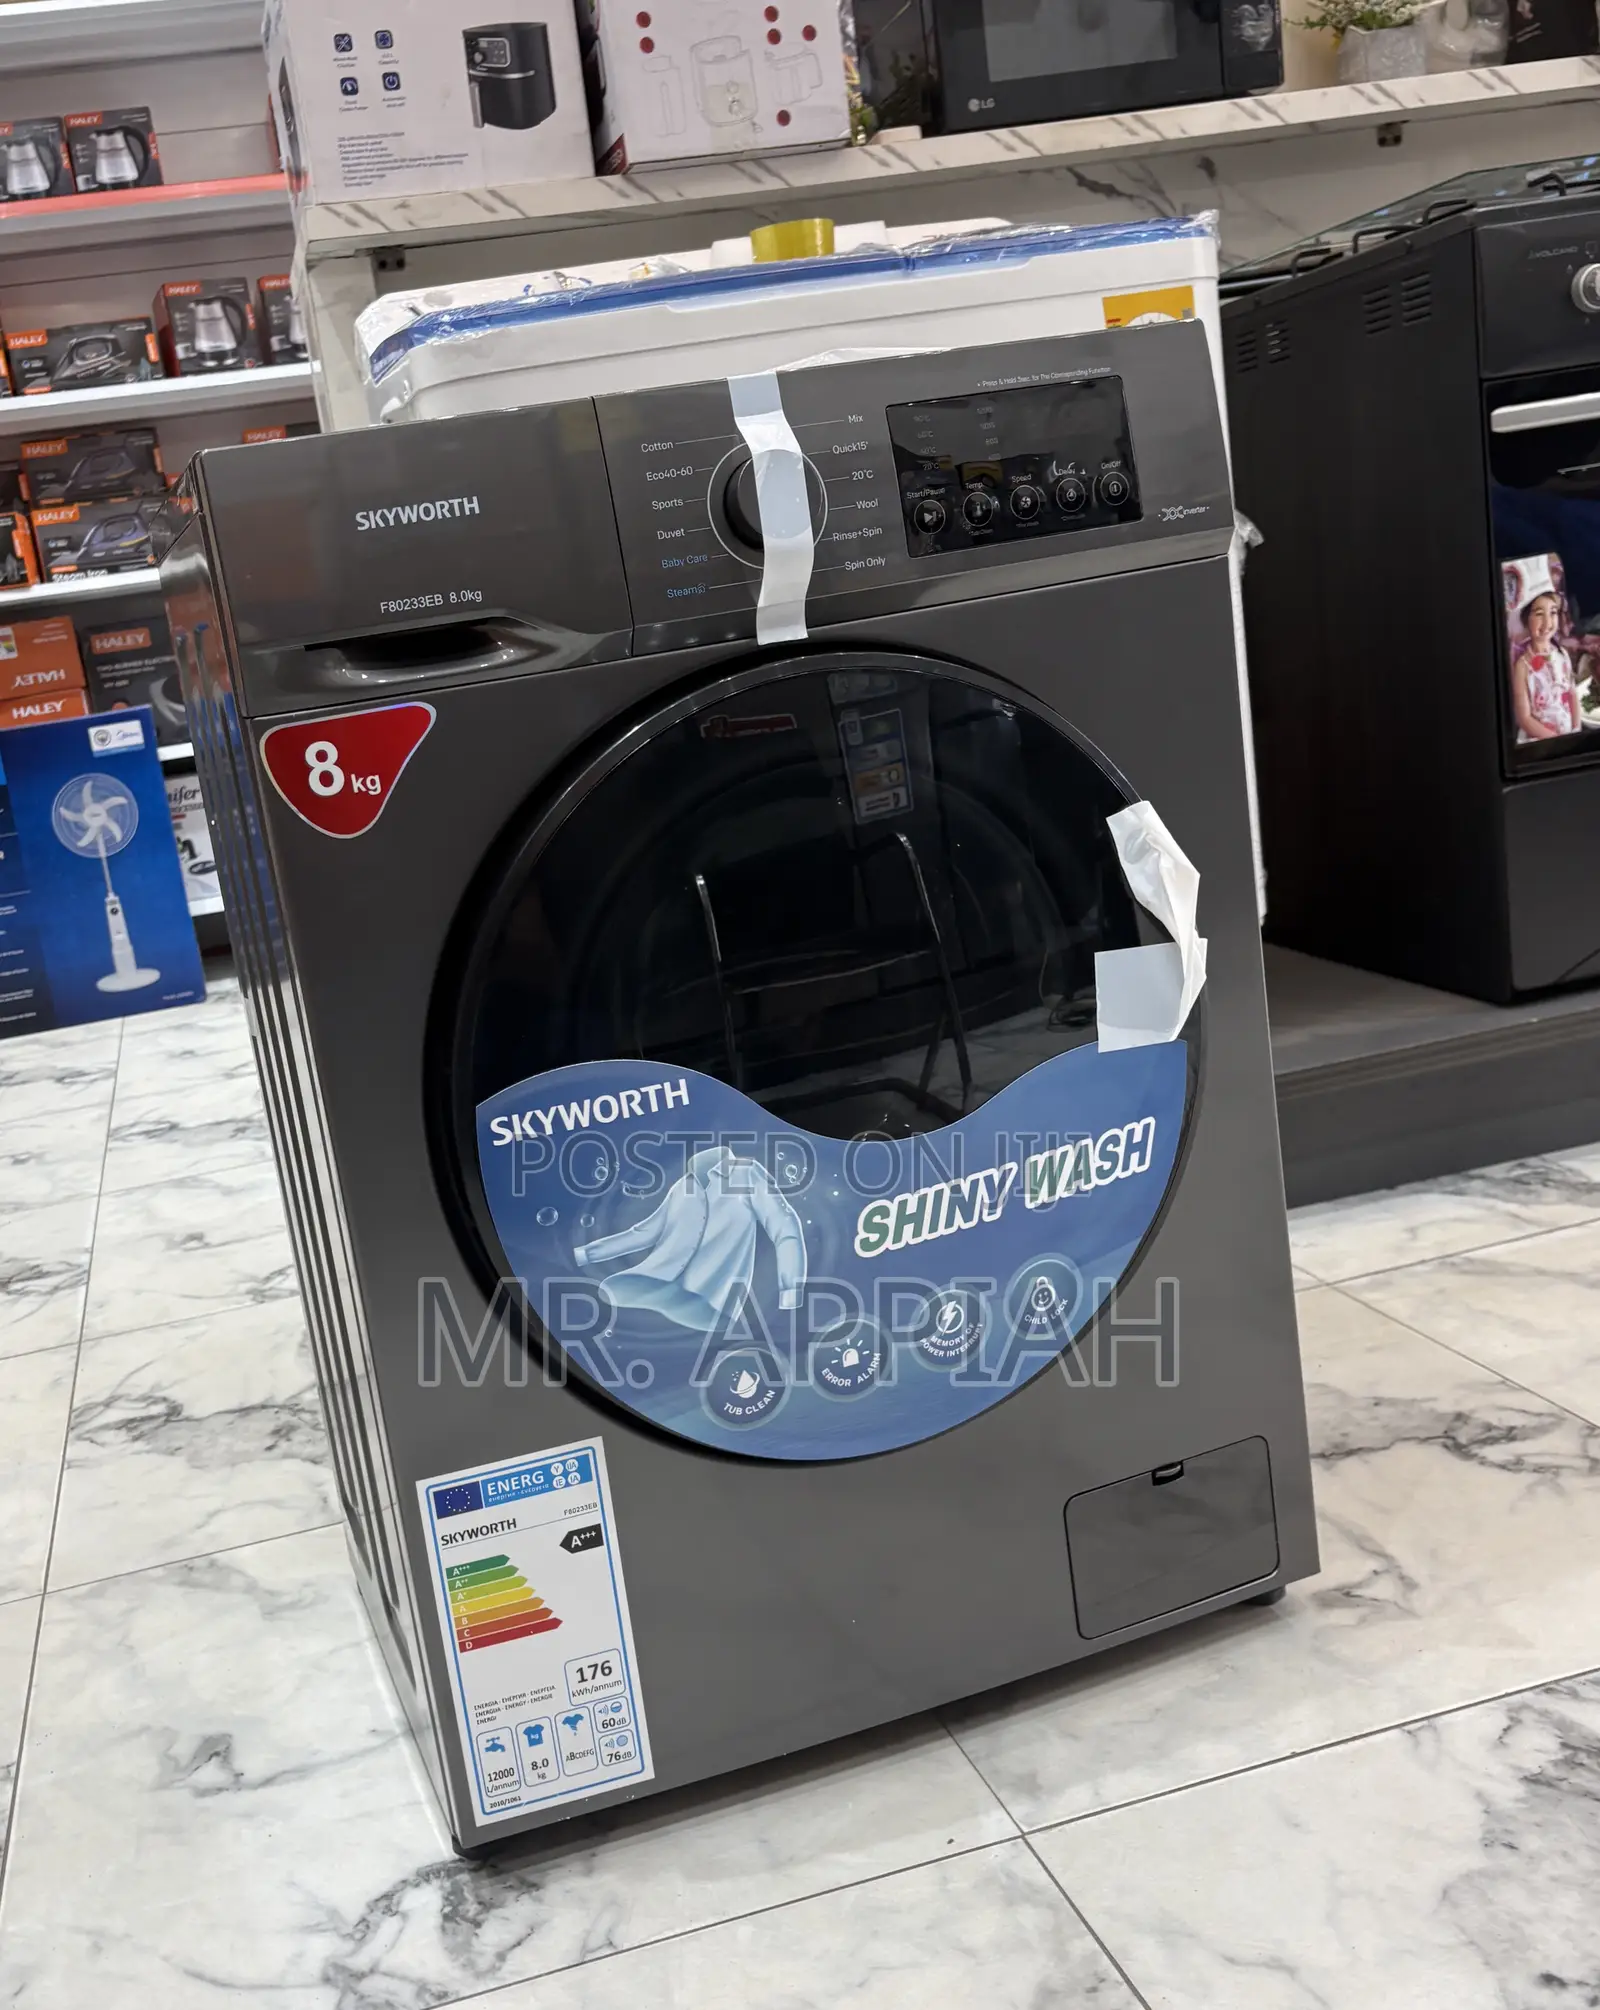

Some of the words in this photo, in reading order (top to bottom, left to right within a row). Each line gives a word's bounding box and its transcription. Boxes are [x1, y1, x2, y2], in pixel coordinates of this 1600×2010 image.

[263, 278, 291, 289] HALE
[9, 333, 44, 347] HALEY
[848, 414, 863, 424] Mix
[26, 442, 64, 455] HALEY
[641, 440, 674, 453] Cotton
[646, 465, 694, 481] Eco40-60
[851, 469, 874, 481] 20°C
[1011, 473, 1032, 484] Speed
[907, 487, 946, 500] Start/Pause
[652, 497, 684, 511] Sports
[856, 499, 879, 510] Wool
[36, 508, 76, 522] HALEY
[355, 496, 481, 531] SKYWORTH
[657, 528, 686, 540] Duvet
[833, 526, 883, 542] Rinse+Spin
[661, 557, 685, 569] Baby
[686, 554, 708, 565] Care
[845, 559, 865, 571] Spin
[866, 556, 886, 568] Only
[52, 571, 86, 582] Steam
[667, 587, 697, 598] Steam
[380, 593, 444, 614] F80233EB
[450, 589, 483, 604] 8.0kg
[95, 633, 145, 650] HALEY
[12, 668, 66, 689] HALEY
[12, 700, 67, 719] HALEY
[305, 741, 345, 797] 8
[351, 773, 382, 796] kg
[489, 1078, 691, 1147] SKYWORTH
[855, 1163, 1017, 1258] SHINY
[1025, 1117, 1155, 1208] WASH
[1024, 1314, 1048, 1325] CHILD
[1050, 1297, 1069, 1320] LOCK
[920, 1338, 944, 1357] POWER
[930, 1335, 965, 1347] MEMORY
[821, 1367, 852, 1387] ERROR
[857, 1351, 881, 1384] ALARM
[724, 1401, 743, 1416] TUB
[744, 1388, 775, 1415] CLEAN
[487, 1470, 545, 1496] ENERG
[564, 1502, 598, 1516] F80233EB
[441, 1518, 517, 1546] SKYWORTH
[571, 1530, 597, 1548] A+++
[461, 1617, 468, 1625] B
[464, 1629, 470, 1637] C
[466, 1641, 473, 1650] D
[576, 1660, 613, 1684] 176
[571, 1679, 622, 1698] kWh/annum
[601, 1717, 616, 1729] 60
[616, 1717, 627, 1727] dB
[565, 1749, 595, 1763] ABCDEFG
[607, 1751, 621, 1763] 76
[622, 1750, 632, 1760] dB
[531, 1758, 549, 1771] 8.0
[487, 1767, 515, 1783] 12000
[537, 1772, 547, 1780] kg
